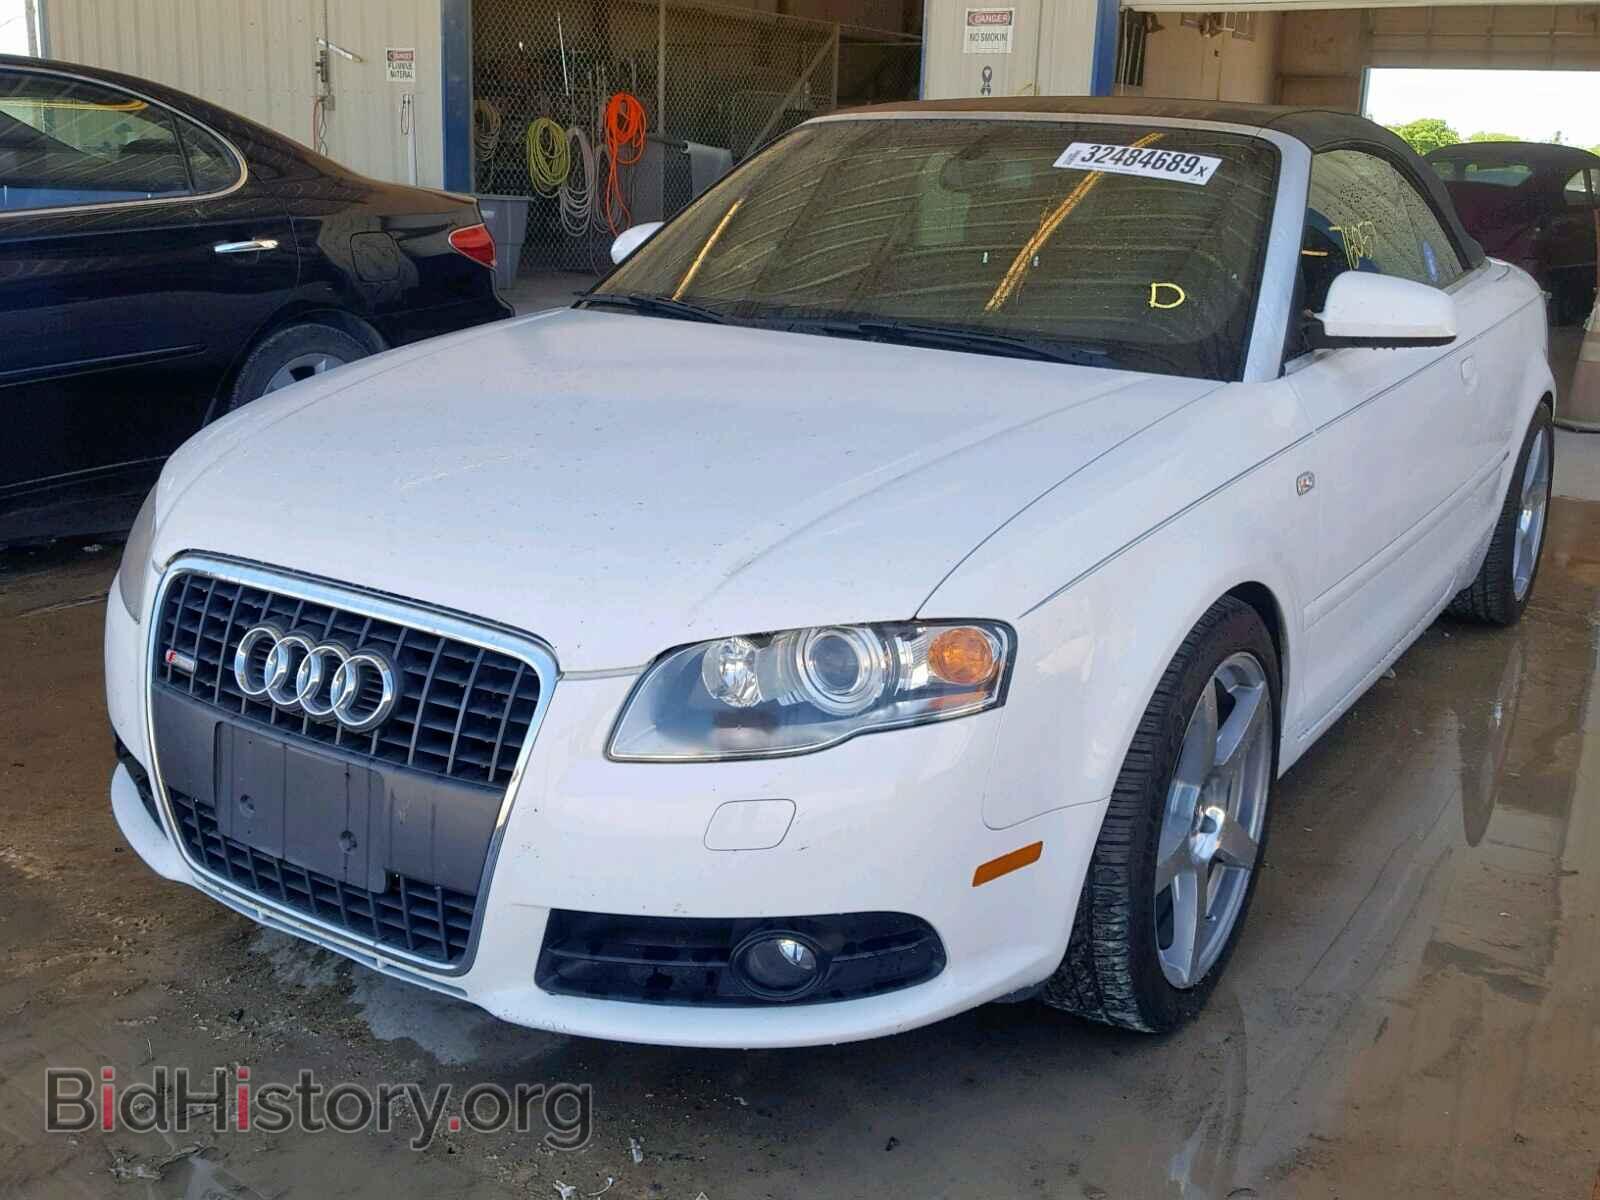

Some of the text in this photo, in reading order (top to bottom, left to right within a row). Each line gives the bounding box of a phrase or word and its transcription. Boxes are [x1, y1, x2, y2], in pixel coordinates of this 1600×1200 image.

[974, 14, 1008, 24] DANGER
[969, 32, 979, 41] NO
[1081, 145, 1200, 174] 32484689
[1150, 282, 1185, 308] D
